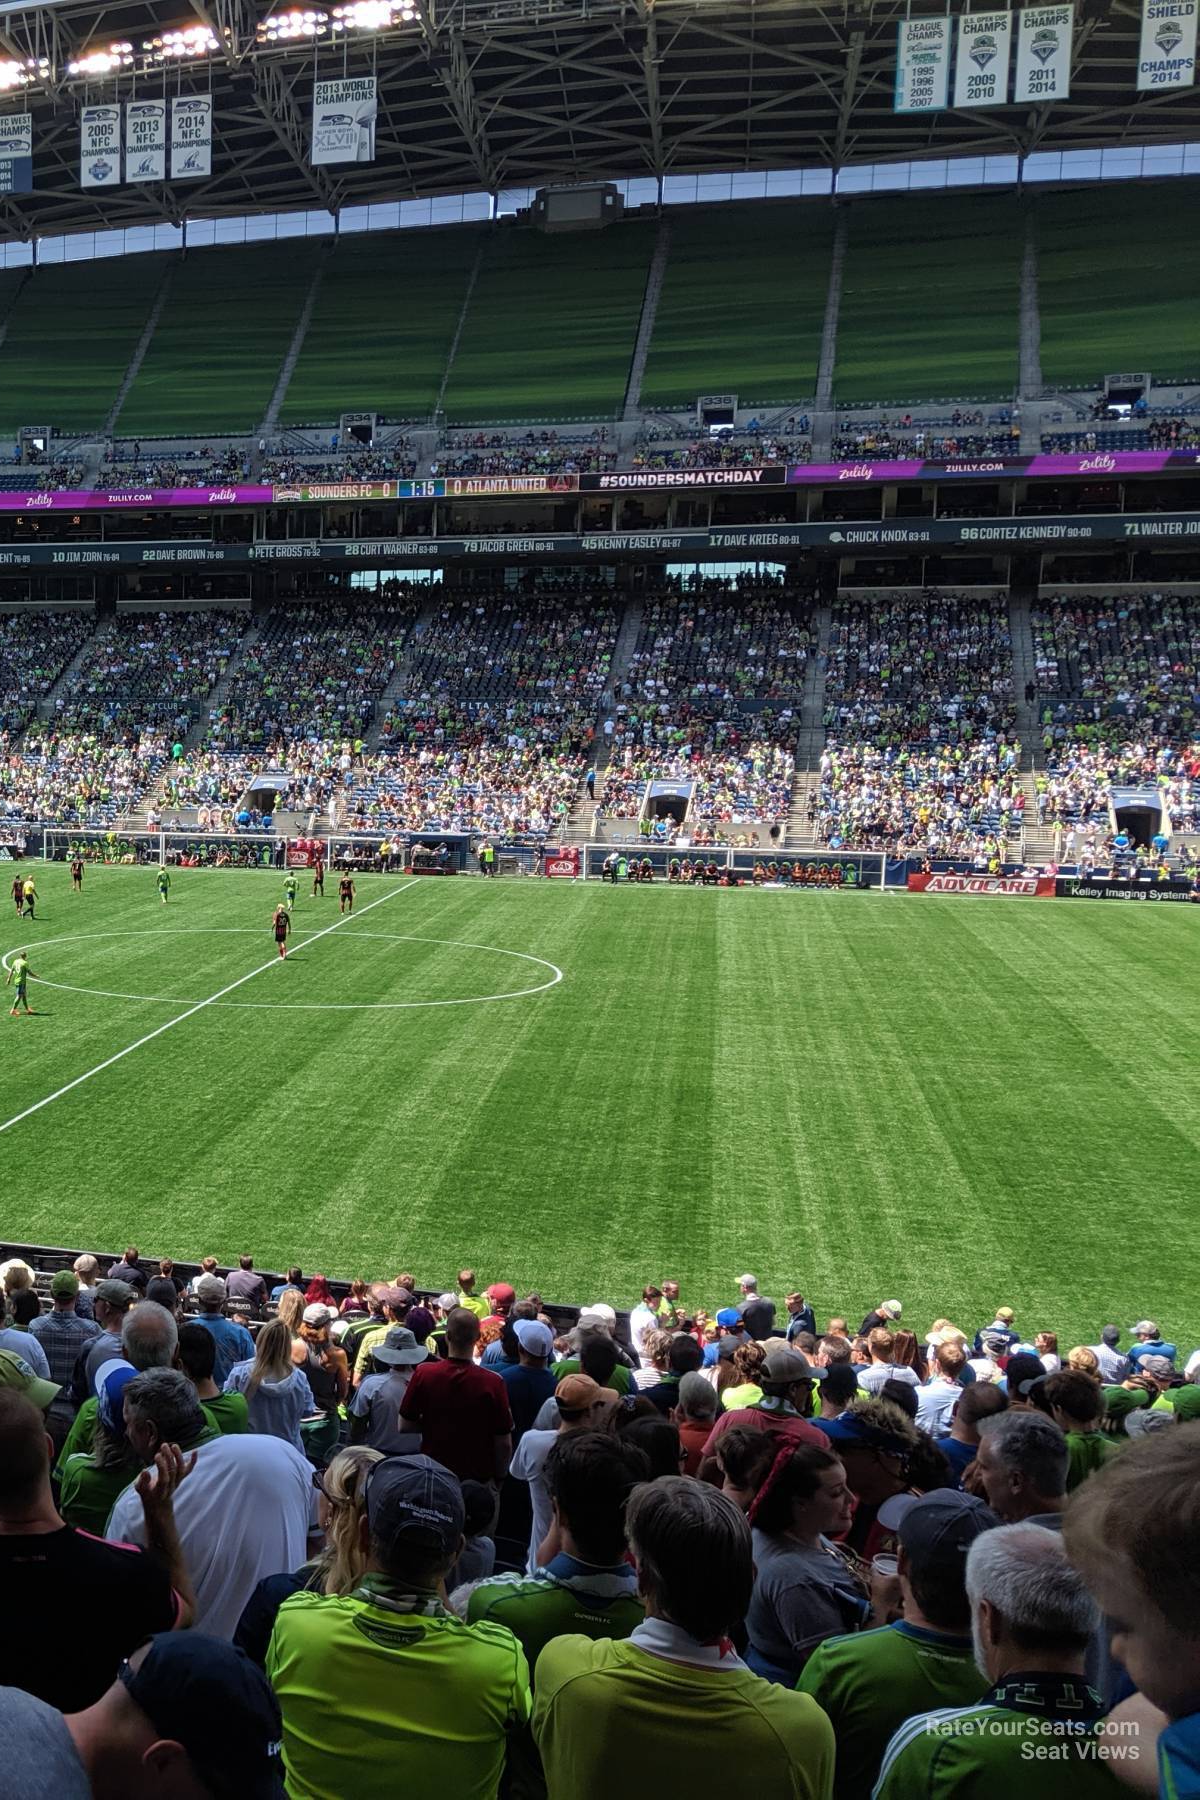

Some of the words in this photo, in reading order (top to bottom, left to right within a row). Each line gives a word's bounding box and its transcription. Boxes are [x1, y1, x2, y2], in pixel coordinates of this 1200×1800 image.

[1147, 4, 1195, 19] SHIELD
[909, 21, 942, 32] LEAGUE
[1024, 14, 1069, 28] CHAMPS
[963, 21, 1008, 35] CHAMPS
[907, 29, 944, 41] CHAMPS
[912, 66, 935, 76] 1995
[1140, 58, 1194, 73] CHAMPS
[967, 74, 996, 87] 2009
[1029, 68, 1056, 81] 2011
[1150, 71, 1181, 83] 2014
[316, 83, 340, 95] 2013
[342, 79, 374, 92] WORLD
[910, 86, 933, 97] 2005
[967, 86, 995, 99] 2010
[1028, 81, 1056, 94] 2014
[315, 90, 374, 105] CHAMPIONS
[909, 97, 933, 107] 2007
[10, 115, 31, 124] WEST
[178, 115, 205, 129] 2014
[87, 123, 114, 137] 2005
[132, 119, 159, 133] 2013
[136, 132, 155, 144] NFC
[181, 128, 201, 139] NFC
[91, 136, 110, 147] NFC
[171, 138, 211, 150] CHAMPIONS
[81, 147, 120, 158] CHAMPIONS
[126, 143, 165, 154] CHAMPIONS
[946, 462, 1004, 473] ZULILY.COM
[599, 470, 763, 488] #SOUNDERSMATCHDAY
[308, 484, 358, 499] SOUNDERS
[360, 484, 372, 497] FC
[382, 482, 390, 497] 0
[410, 480, 435, 496] 1:15
[453, 480, 462, 495] 0
[466, 479, 509, 493] ATLANTA
[511, 477, 546, 491] UNITED
[960, 528, 979, 539] 96
[979, 527, 1017, 539] CORTEZ
[1019, 526, 1067, 538] KENNEDY
[1124, 523, 1141, 535] 71
[1141, 523, 1182, 535] WALTER
[709, 535, 723, 546] 17
[724, 534, 747, 545] DAVE
[749, 533, 778, 545] KRIEG
[846, 531, 878, 543] CHUCK
[881, 530, 907, 542] KNOX
[464, 543, 478, 552] 79
[478, 541, 505, 552] JACOB
[506, 541, 534, 551] GREEN
[581, 539, 598, 549] 45
[598, 538, 627, 549] KENNY
[629, 537, 661, 548] EASLEY
[142, 551, 156, 561] 22
[156, 550, 175, 560] DAVE
[177, 549, 206, 560] BROWN
[255, 549, 273, 558] PETE
[275, 547, 302, 557] GROSS
[345, 545, 360, 555] 28
[360, 545, 381, 555] CURT
[383, 544, 418, 554] WARNER
[52, 553, 65, 562] 10
[66, 552, 79, 562] JIM
[81, 552, 102, 562] ZORN
[926, 877, 1036, 893] ADVOCARE
[1071, 887, 1103, 897] Kelley
[1105, 889, 1146, 899] Imaging
